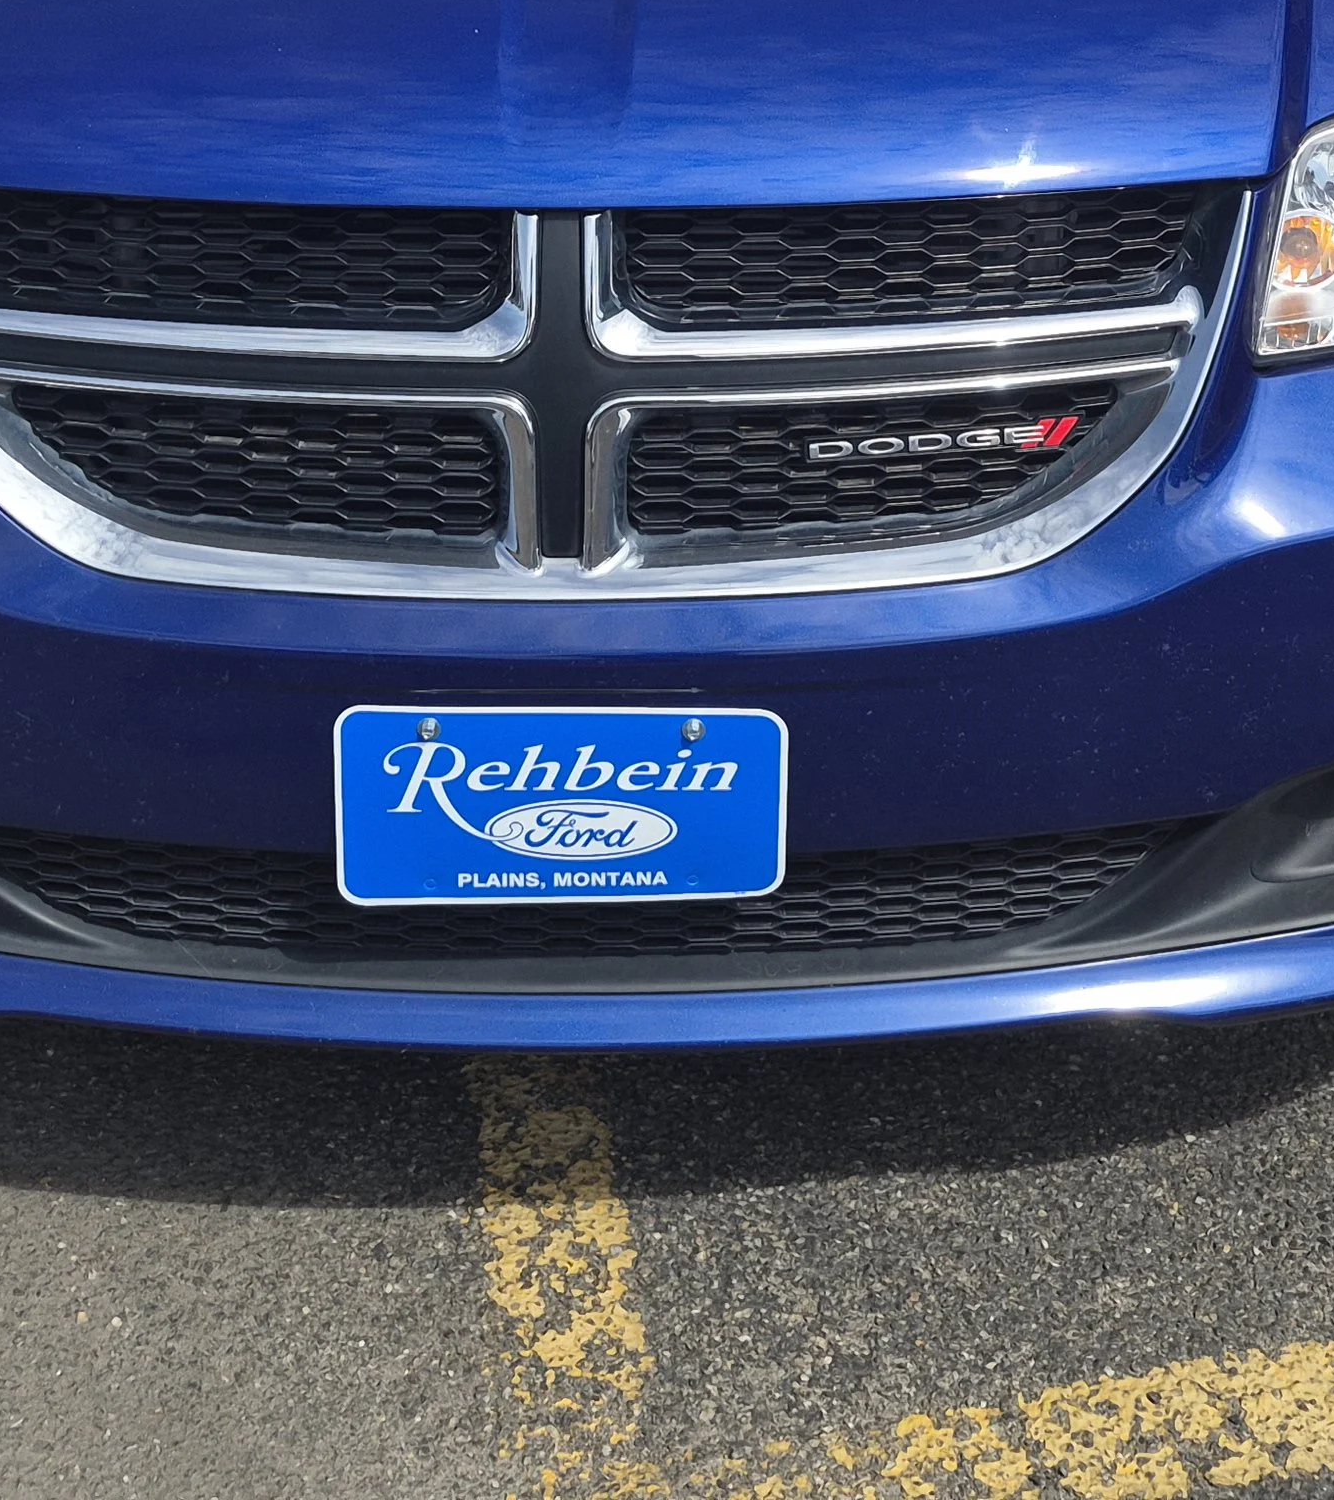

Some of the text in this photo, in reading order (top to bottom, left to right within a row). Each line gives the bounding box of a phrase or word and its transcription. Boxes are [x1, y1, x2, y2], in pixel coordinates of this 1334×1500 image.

[808, 424, 1045, 461] DODGE
[382, 741, 739, 822] Rehbein
[523, 808, 639, 849] Ford
[457, 870, 668, 891] PLAINS, MONTANA
